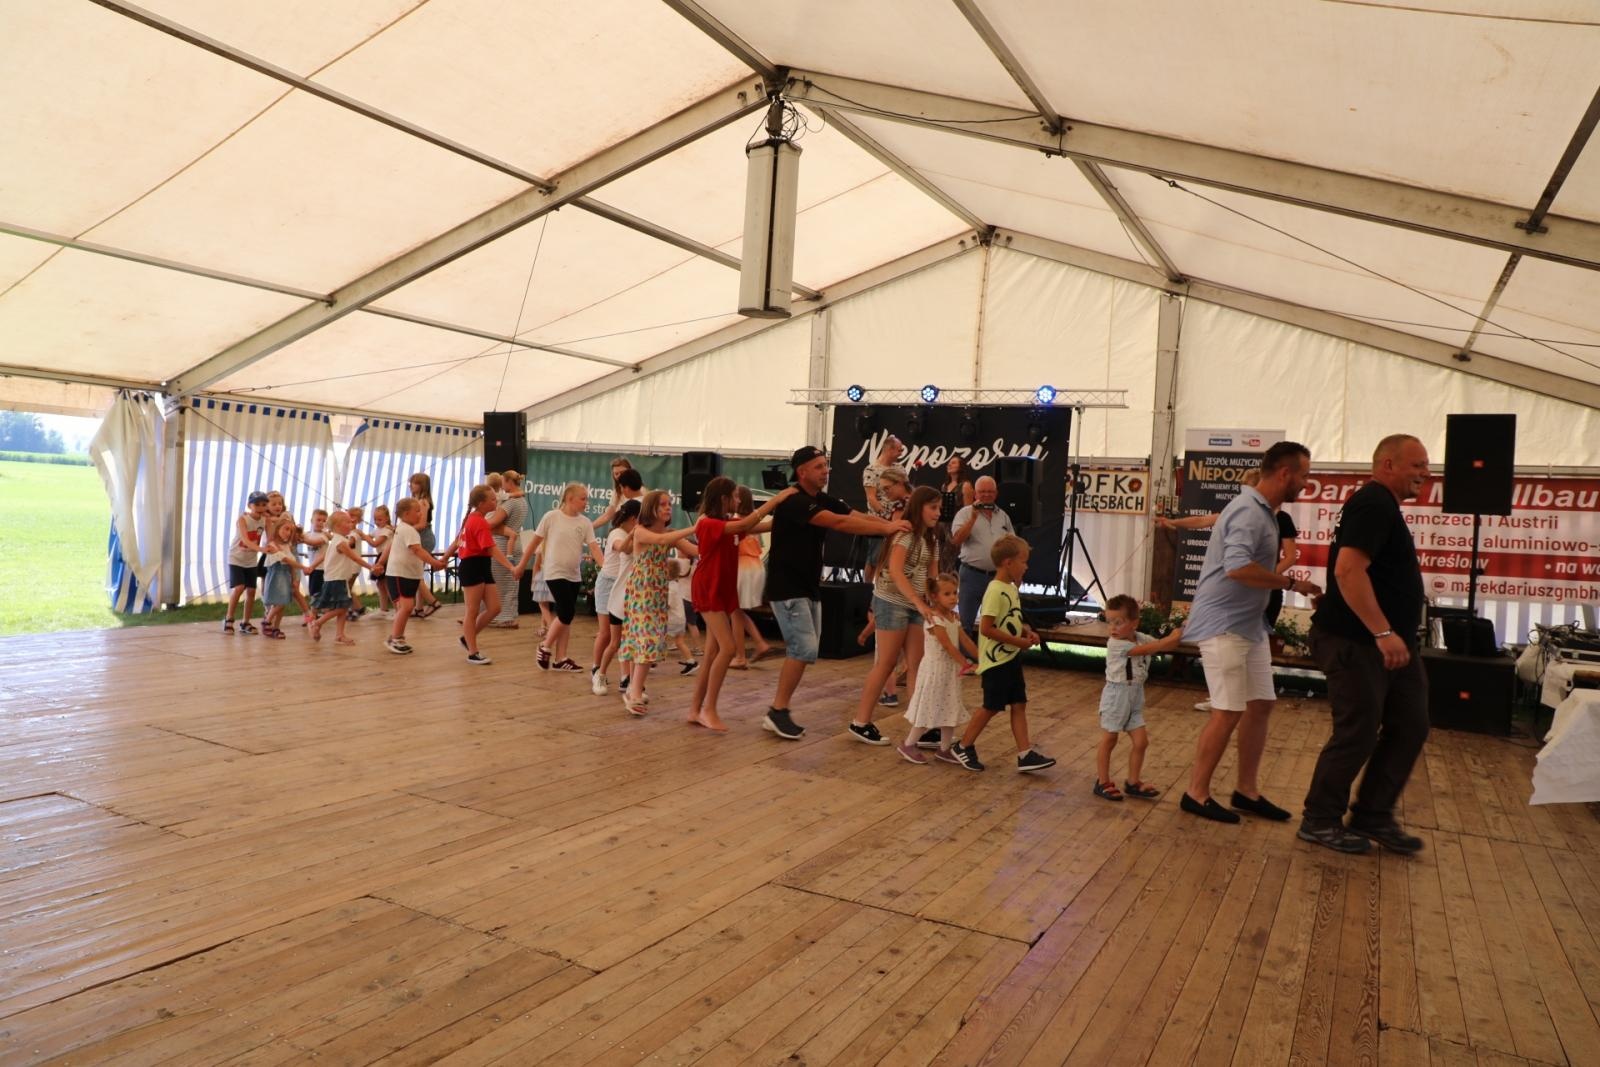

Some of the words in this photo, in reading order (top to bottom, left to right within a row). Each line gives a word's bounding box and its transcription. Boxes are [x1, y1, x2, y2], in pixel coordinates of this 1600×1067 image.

[848, 429, 1049, 475] Nepozorni
[1188, 460, 1244, 482] NIEPOZ
[1079, 473, 1129, 494] DFK
[1498, 516, 1559, 530] Austrii
[1483, 535, 1600, 552] aluminiowo-
[1555, 561, 1577, 574] na
